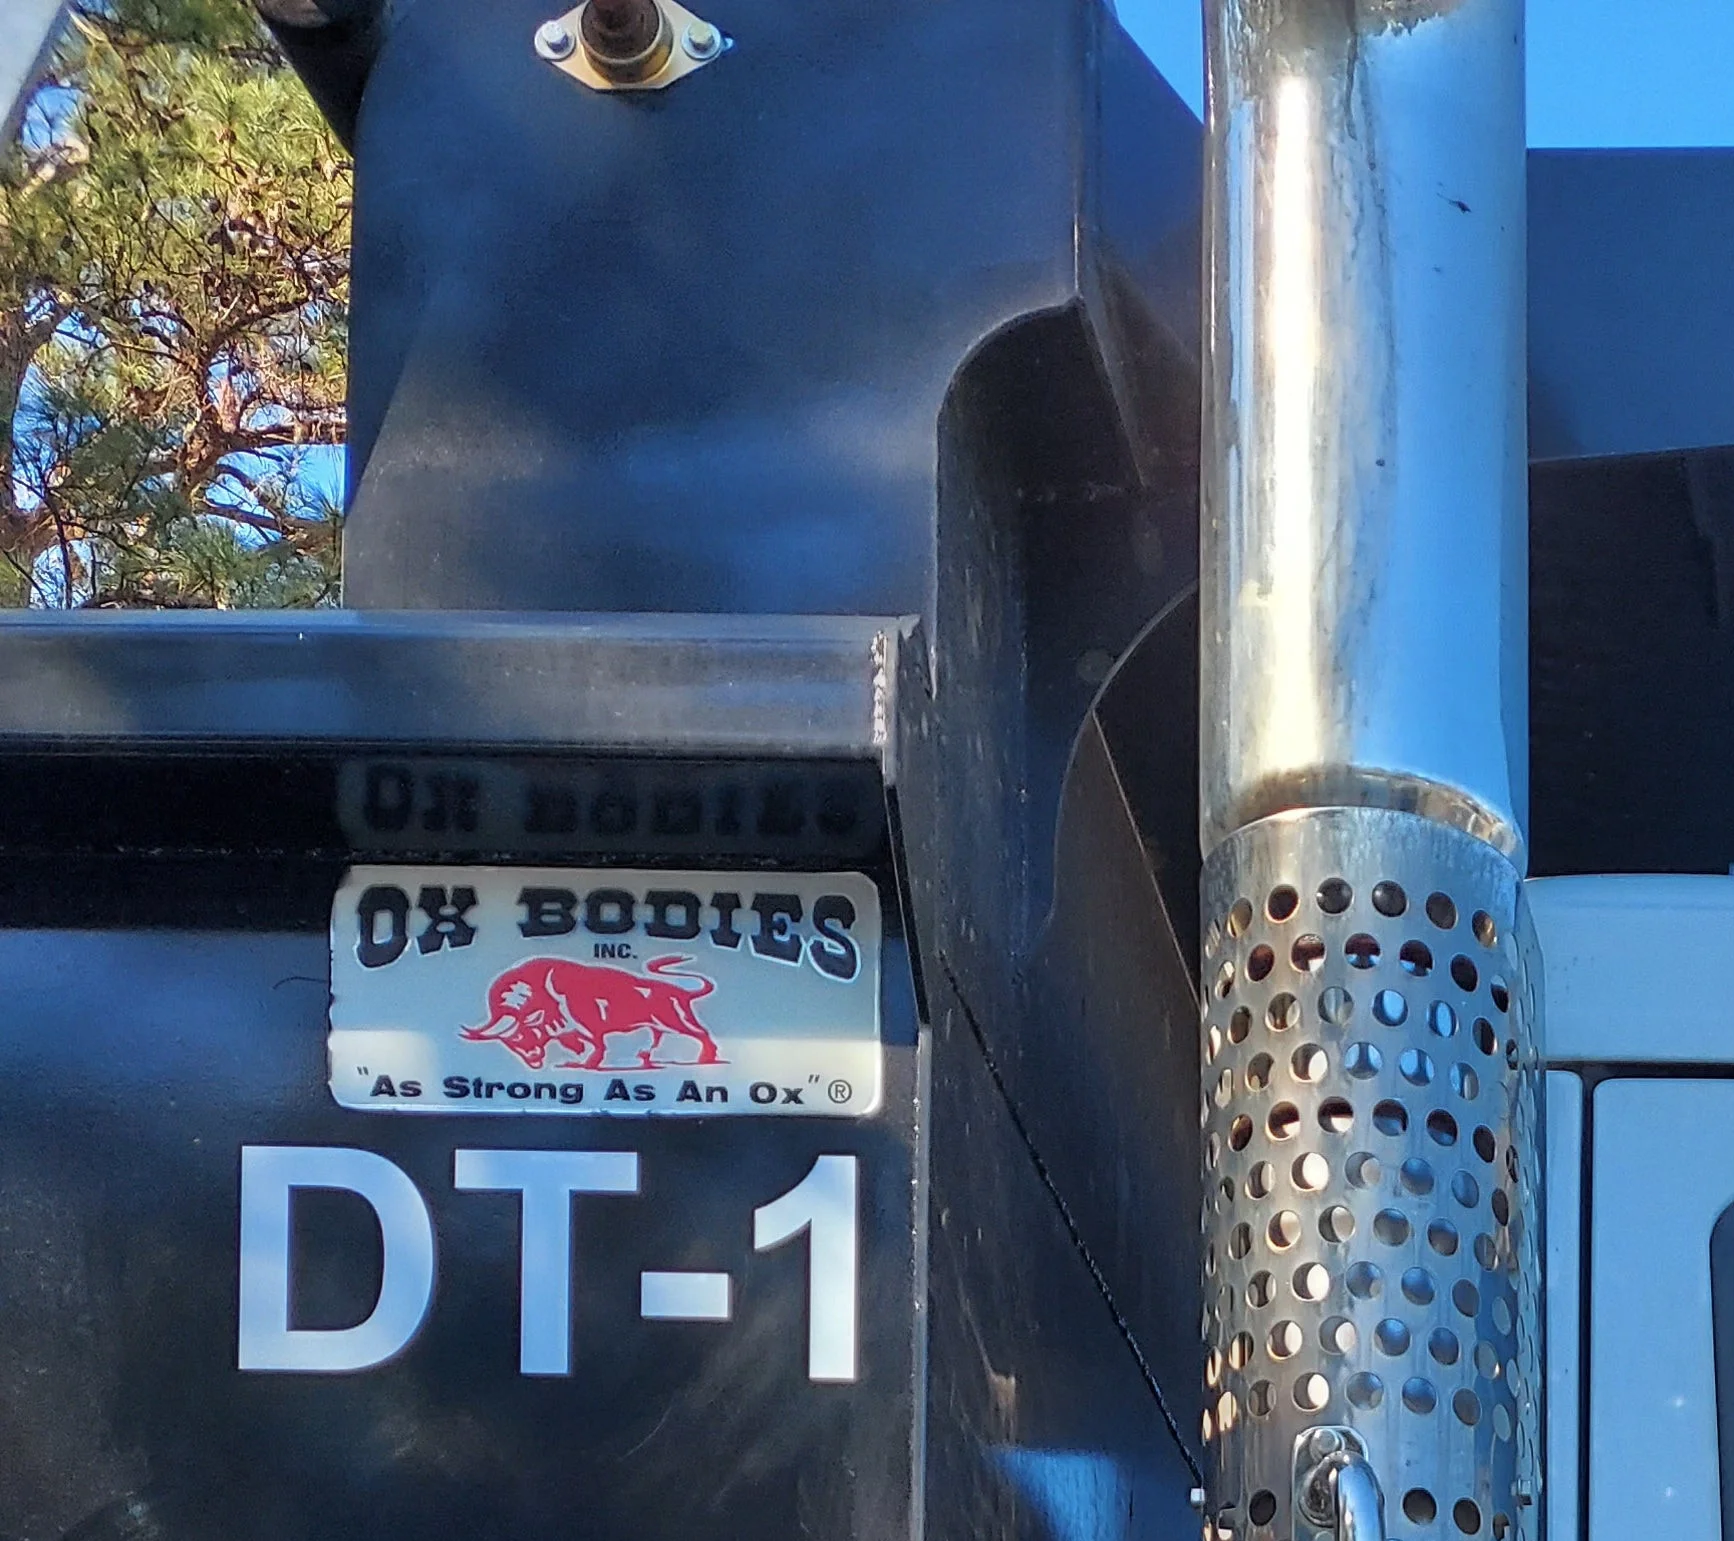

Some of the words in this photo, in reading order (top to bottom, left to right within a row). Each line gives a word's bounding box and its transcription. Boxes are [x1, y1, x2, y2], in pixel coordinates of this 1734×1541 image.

[355, 884, 479, 969] OX
[516, 887, 862, 982] BODIES
[593, 942, 639, 960] INC.
[443, 1074, 585, 1105] Strong
[603, 1078, 657, 1103] As
[676, 1079, 729, 1104] An
[237, 1144, 859, 1382] DT-1
